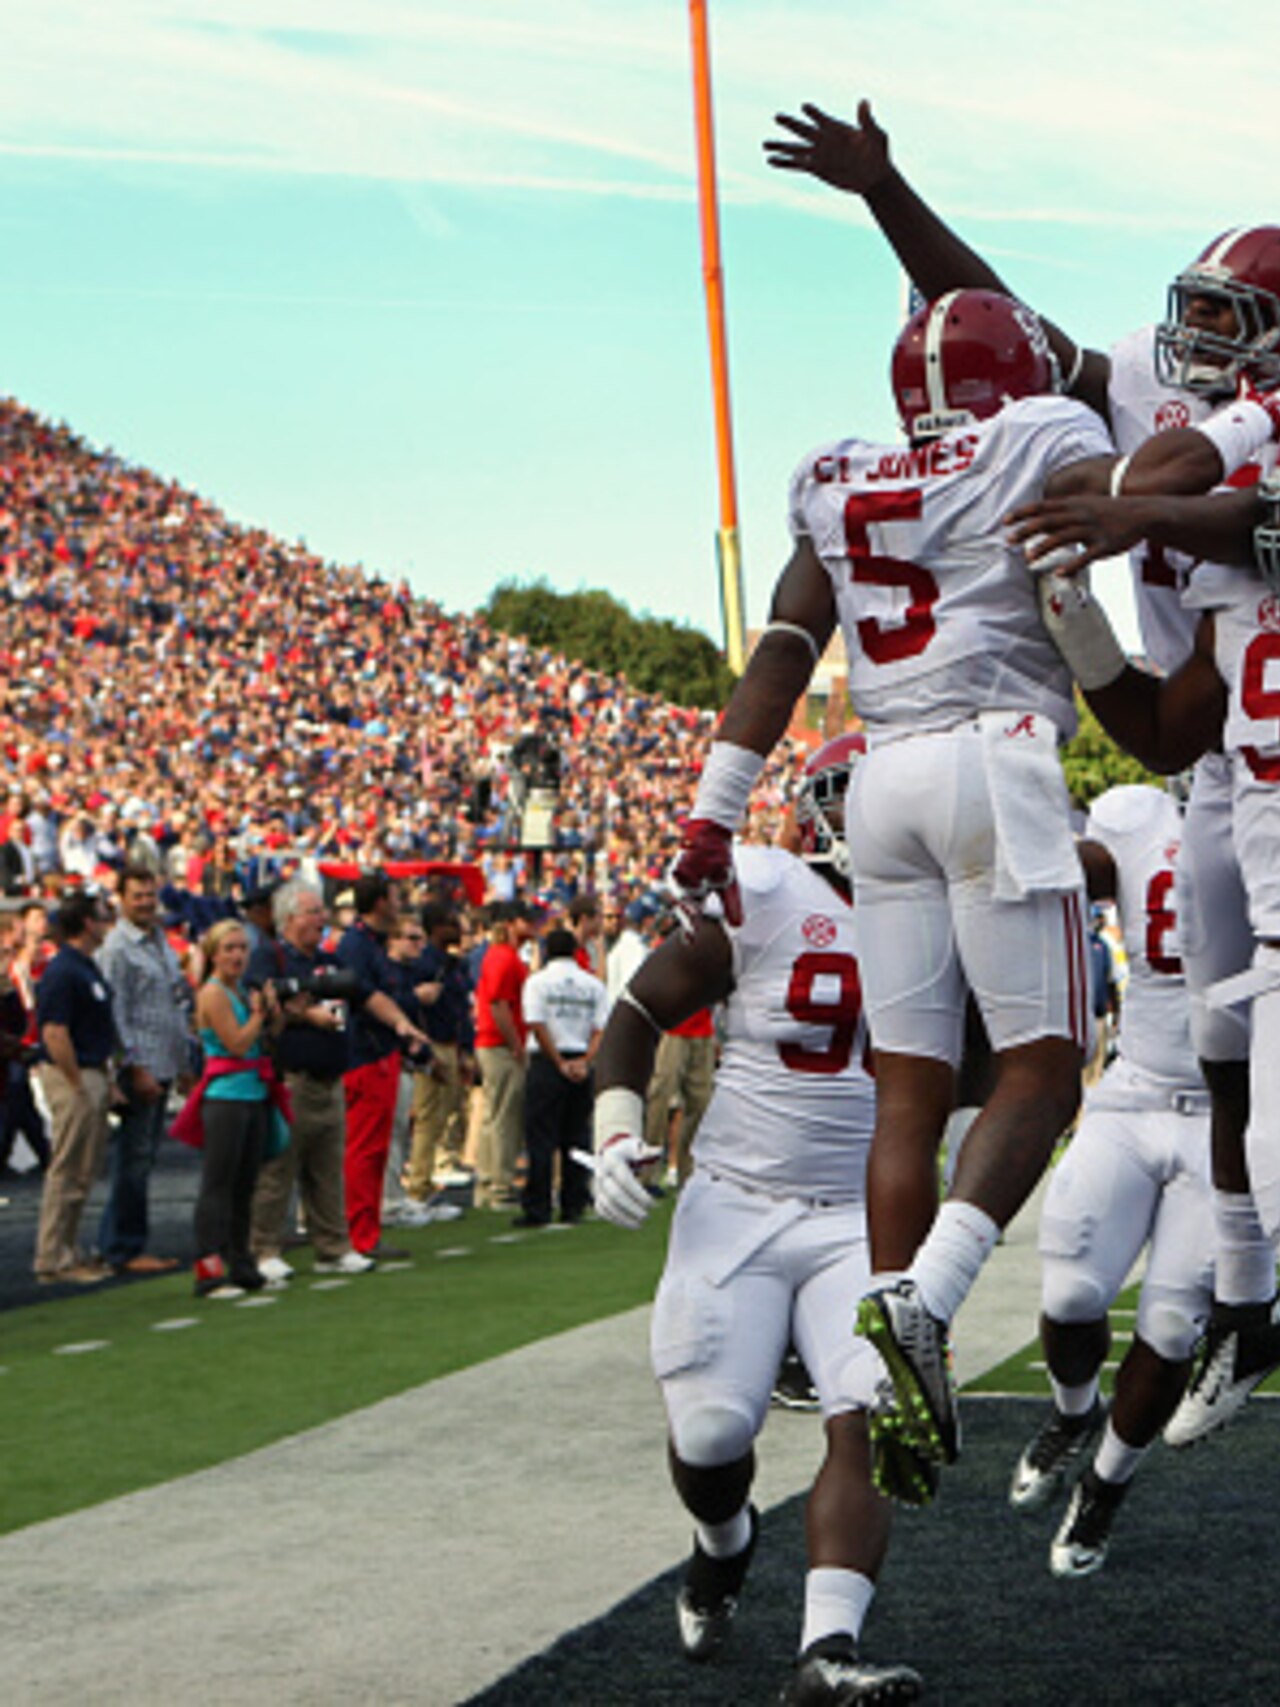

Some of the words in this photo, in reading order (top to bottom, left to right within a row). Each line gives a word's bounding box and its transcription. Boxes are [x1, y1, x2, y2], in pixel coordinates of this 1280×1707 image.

[866, 434, 979, 483] JONES
[844, 488, 940, 666] 5
[777, 952, 876, 1078] 9
